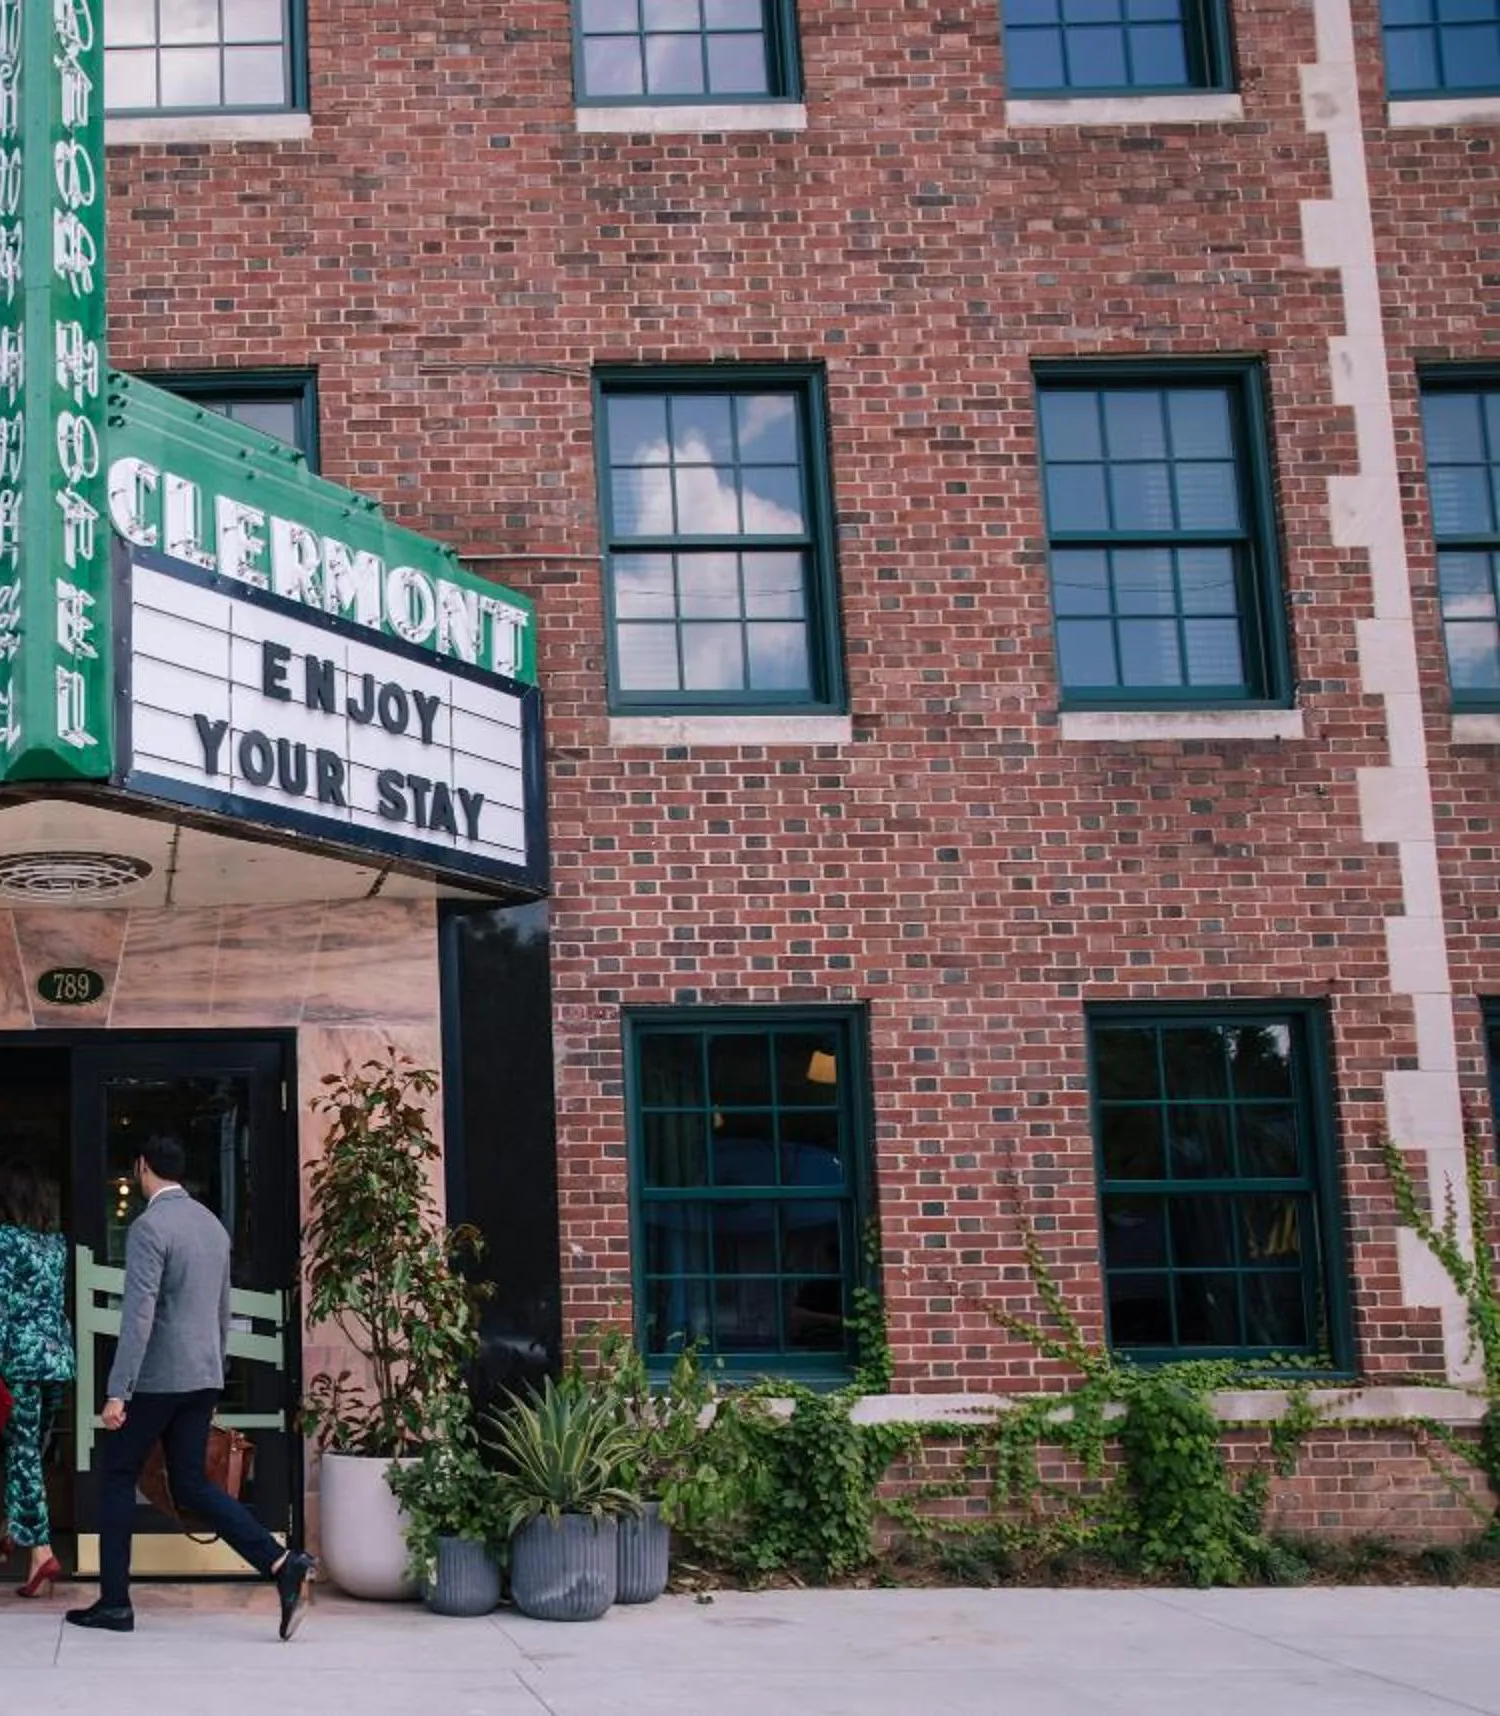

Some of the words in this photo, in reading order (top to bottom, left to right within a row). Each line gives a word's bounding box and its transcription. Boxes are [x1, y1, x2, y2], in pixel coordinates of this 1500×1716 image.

[55, 320, 99, 748] HOTEL
[108, 457, 529, 677] CLERMONT
[263, 640, 440, 744] ENJOY
[194, 714, 346, 807] YOUR
[377, 770, 485, 841] STAY
[53, 974, 90, 999] 789
